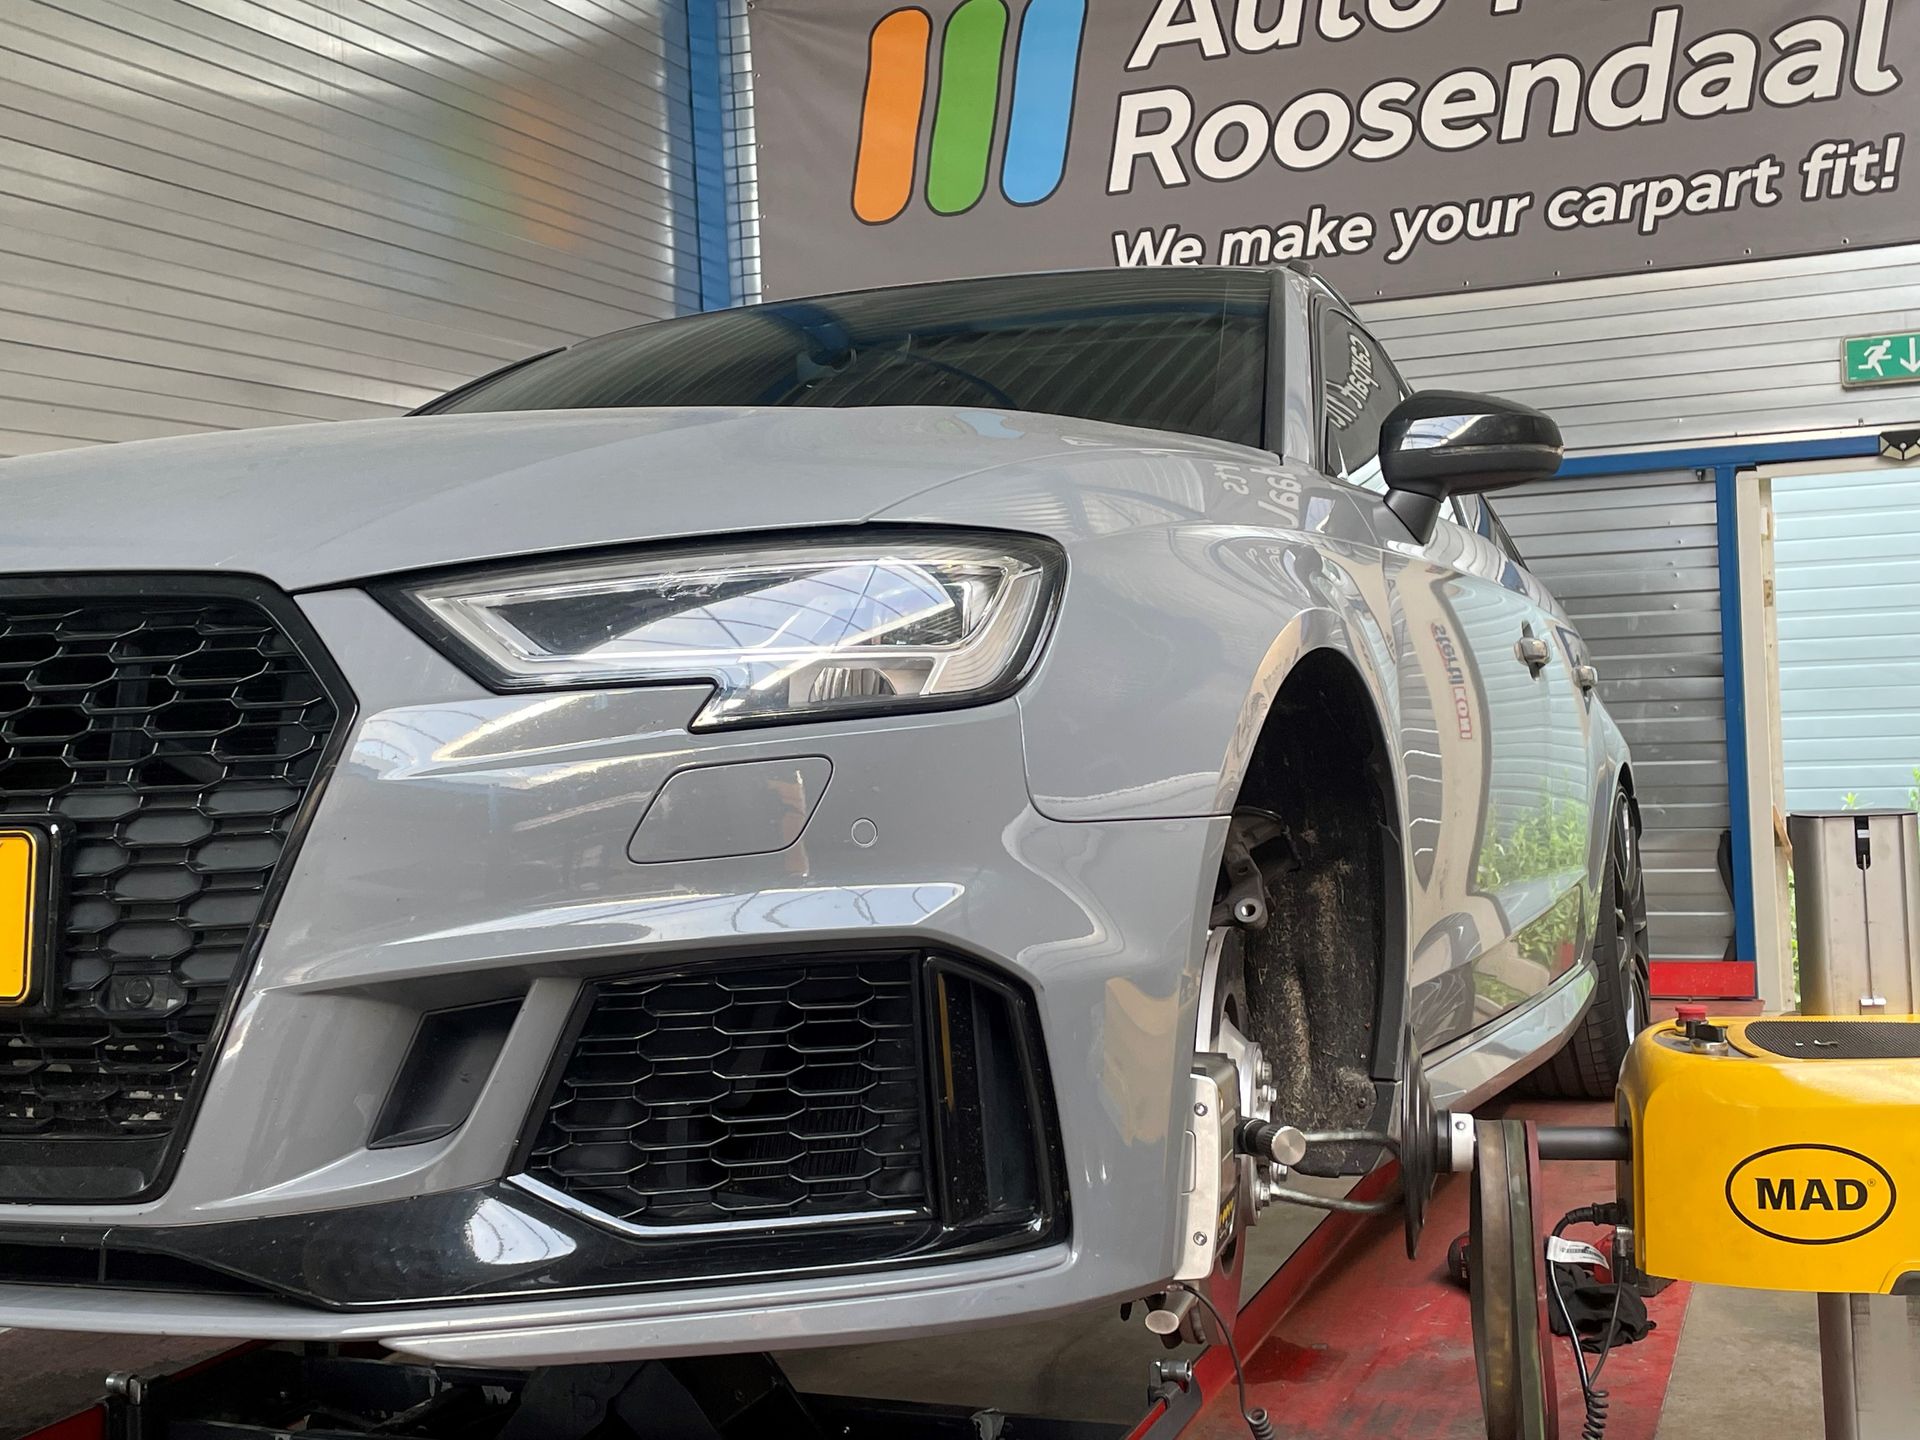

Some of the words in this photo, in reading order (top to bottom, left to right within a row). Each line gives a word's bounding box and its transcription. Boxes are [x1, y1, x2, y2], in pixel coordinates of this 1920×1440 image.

[1109, 0, 1898, 192] Roosendaal
[1114, 228, 1202, 267] We
[1220, 208, 1373, 267] make
[1388, 196, 1531, 261] your
[1548, 158, 1780, 232] carpart
[1803, 137, 1900, 198] fit!
[1755, 1177, 1868, 1211] MAD
